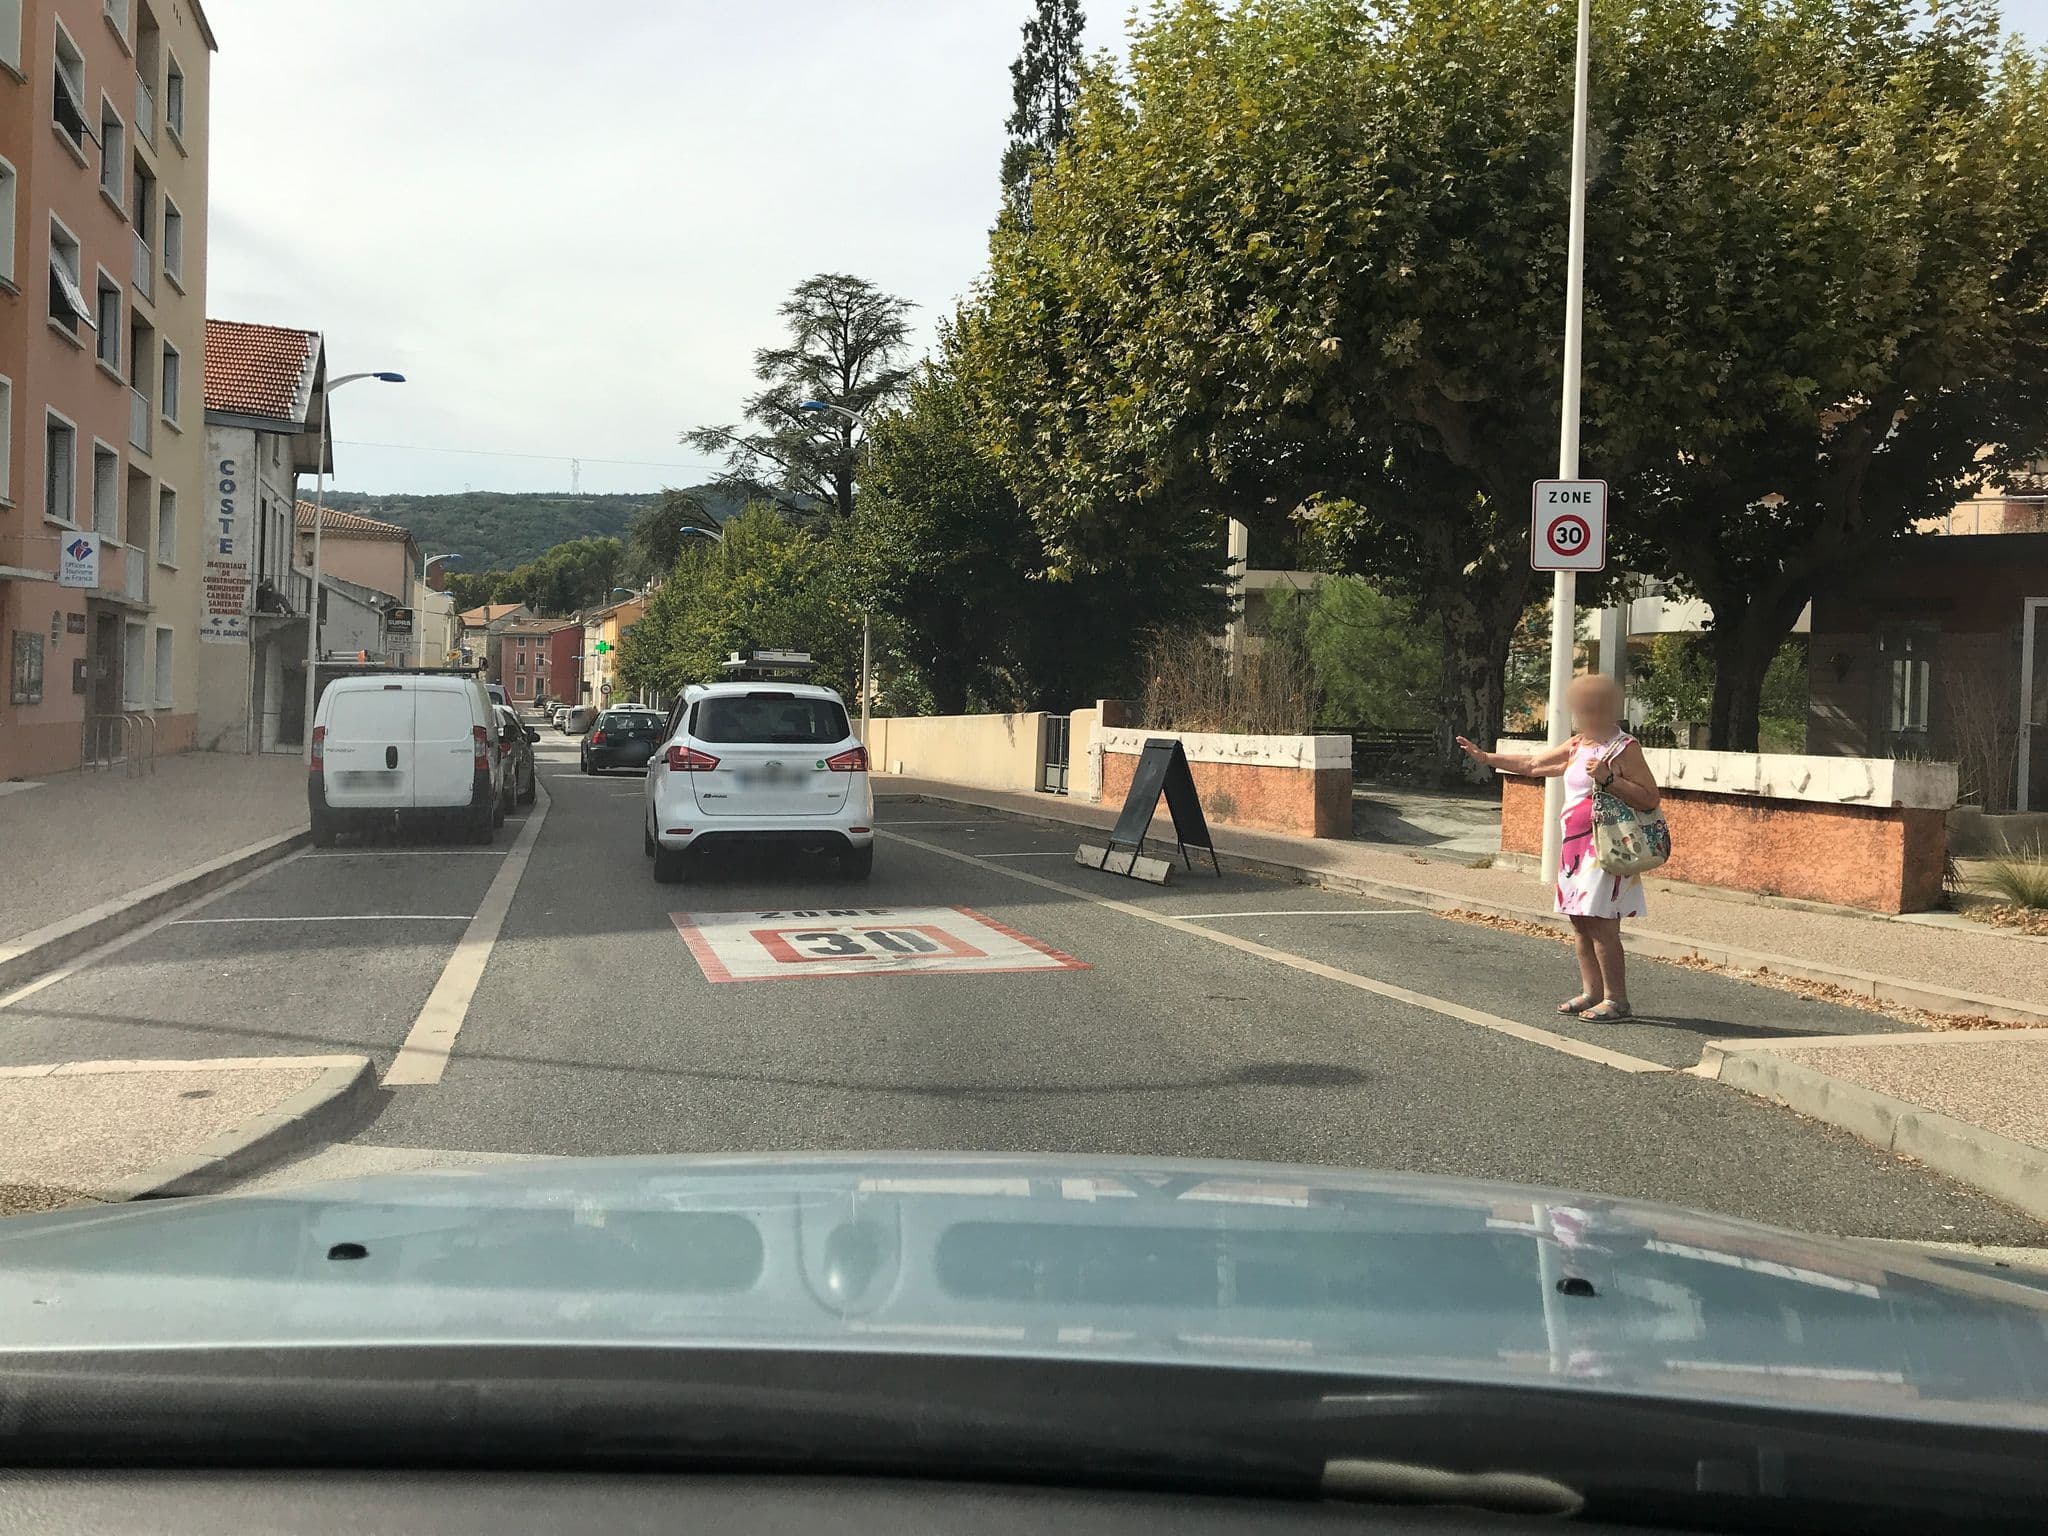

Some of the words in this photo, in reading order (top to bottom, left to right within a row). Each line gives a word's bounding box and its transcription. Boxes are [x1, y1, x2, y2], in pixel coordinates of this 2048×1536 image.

[1549, 491, 1592, 503] ZONE
[219, 459, 236, 555] COSTE
[1556, 527, 1582, 544] 30
[208, 600, 243, 608] SANITAIRE
[755, 909, 897, 919] ZONE
[795, 931, 939, 955] 30
